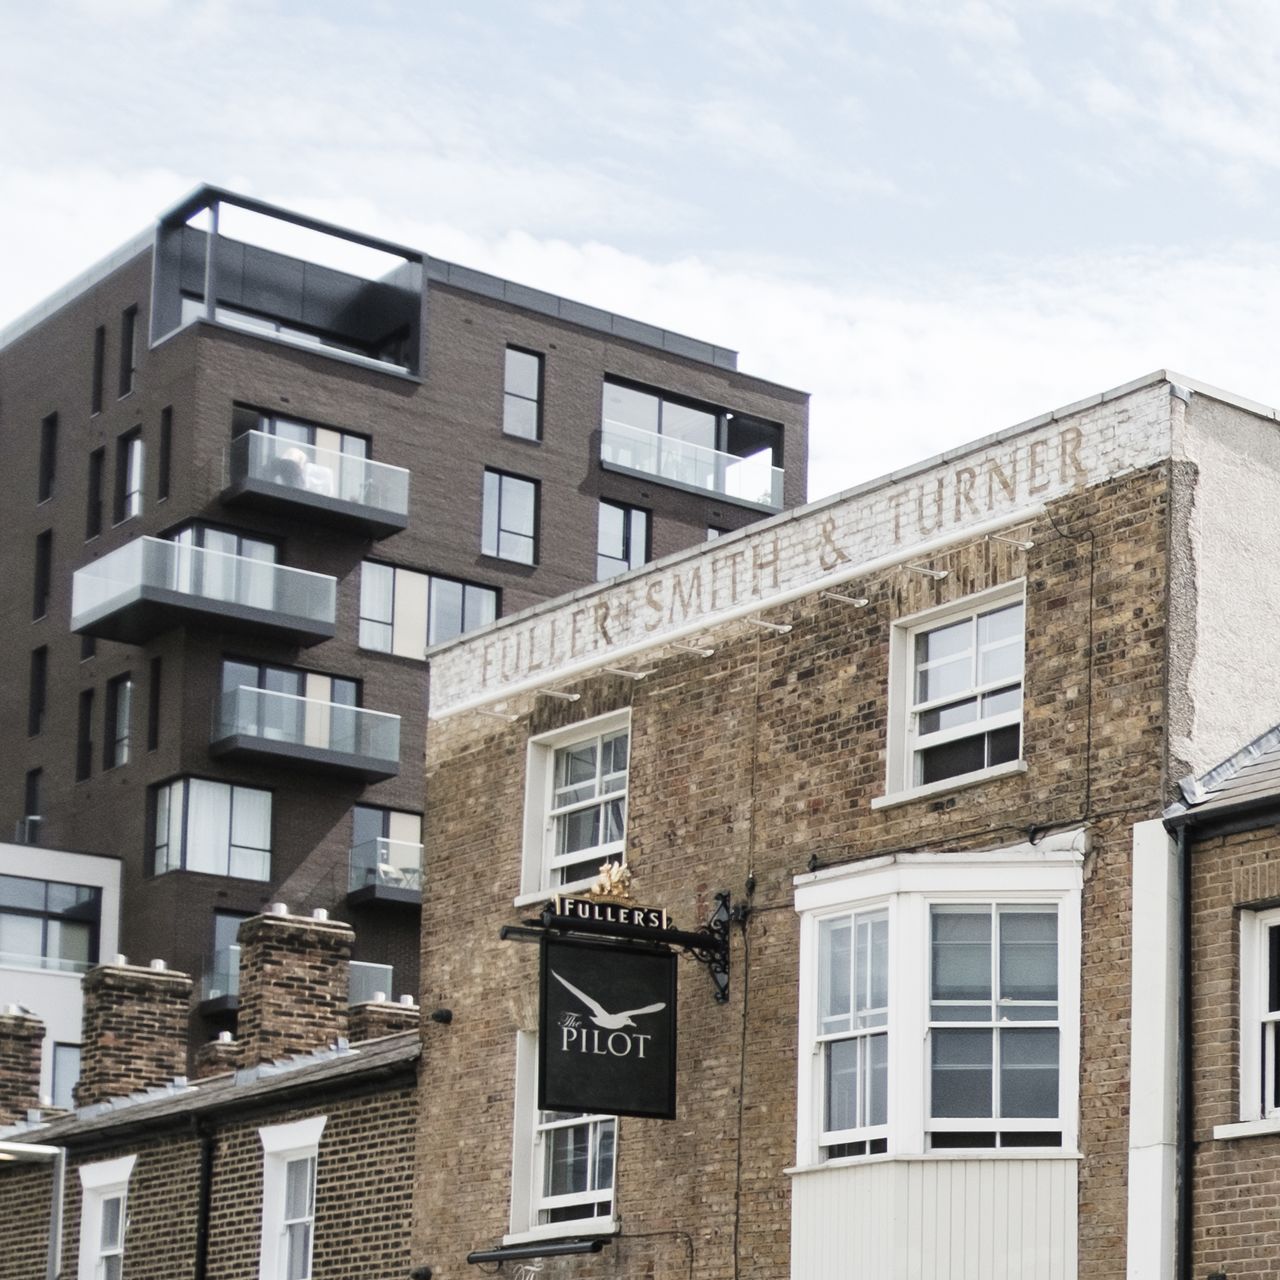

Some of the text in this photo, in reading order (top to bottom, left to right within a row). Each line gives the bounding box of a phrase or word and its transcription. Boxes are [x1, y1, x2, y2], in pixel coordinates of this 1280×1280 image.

[644, 536, 780, 632] SMITH
[819, 516, 852, 572] &
[889, 426, 1087, 545] TURNER
[563, 898, 660, 928] FULLER'S
[557, 1011, 583, 1028] The
[561, 1026, 652, 1058] PILOT
